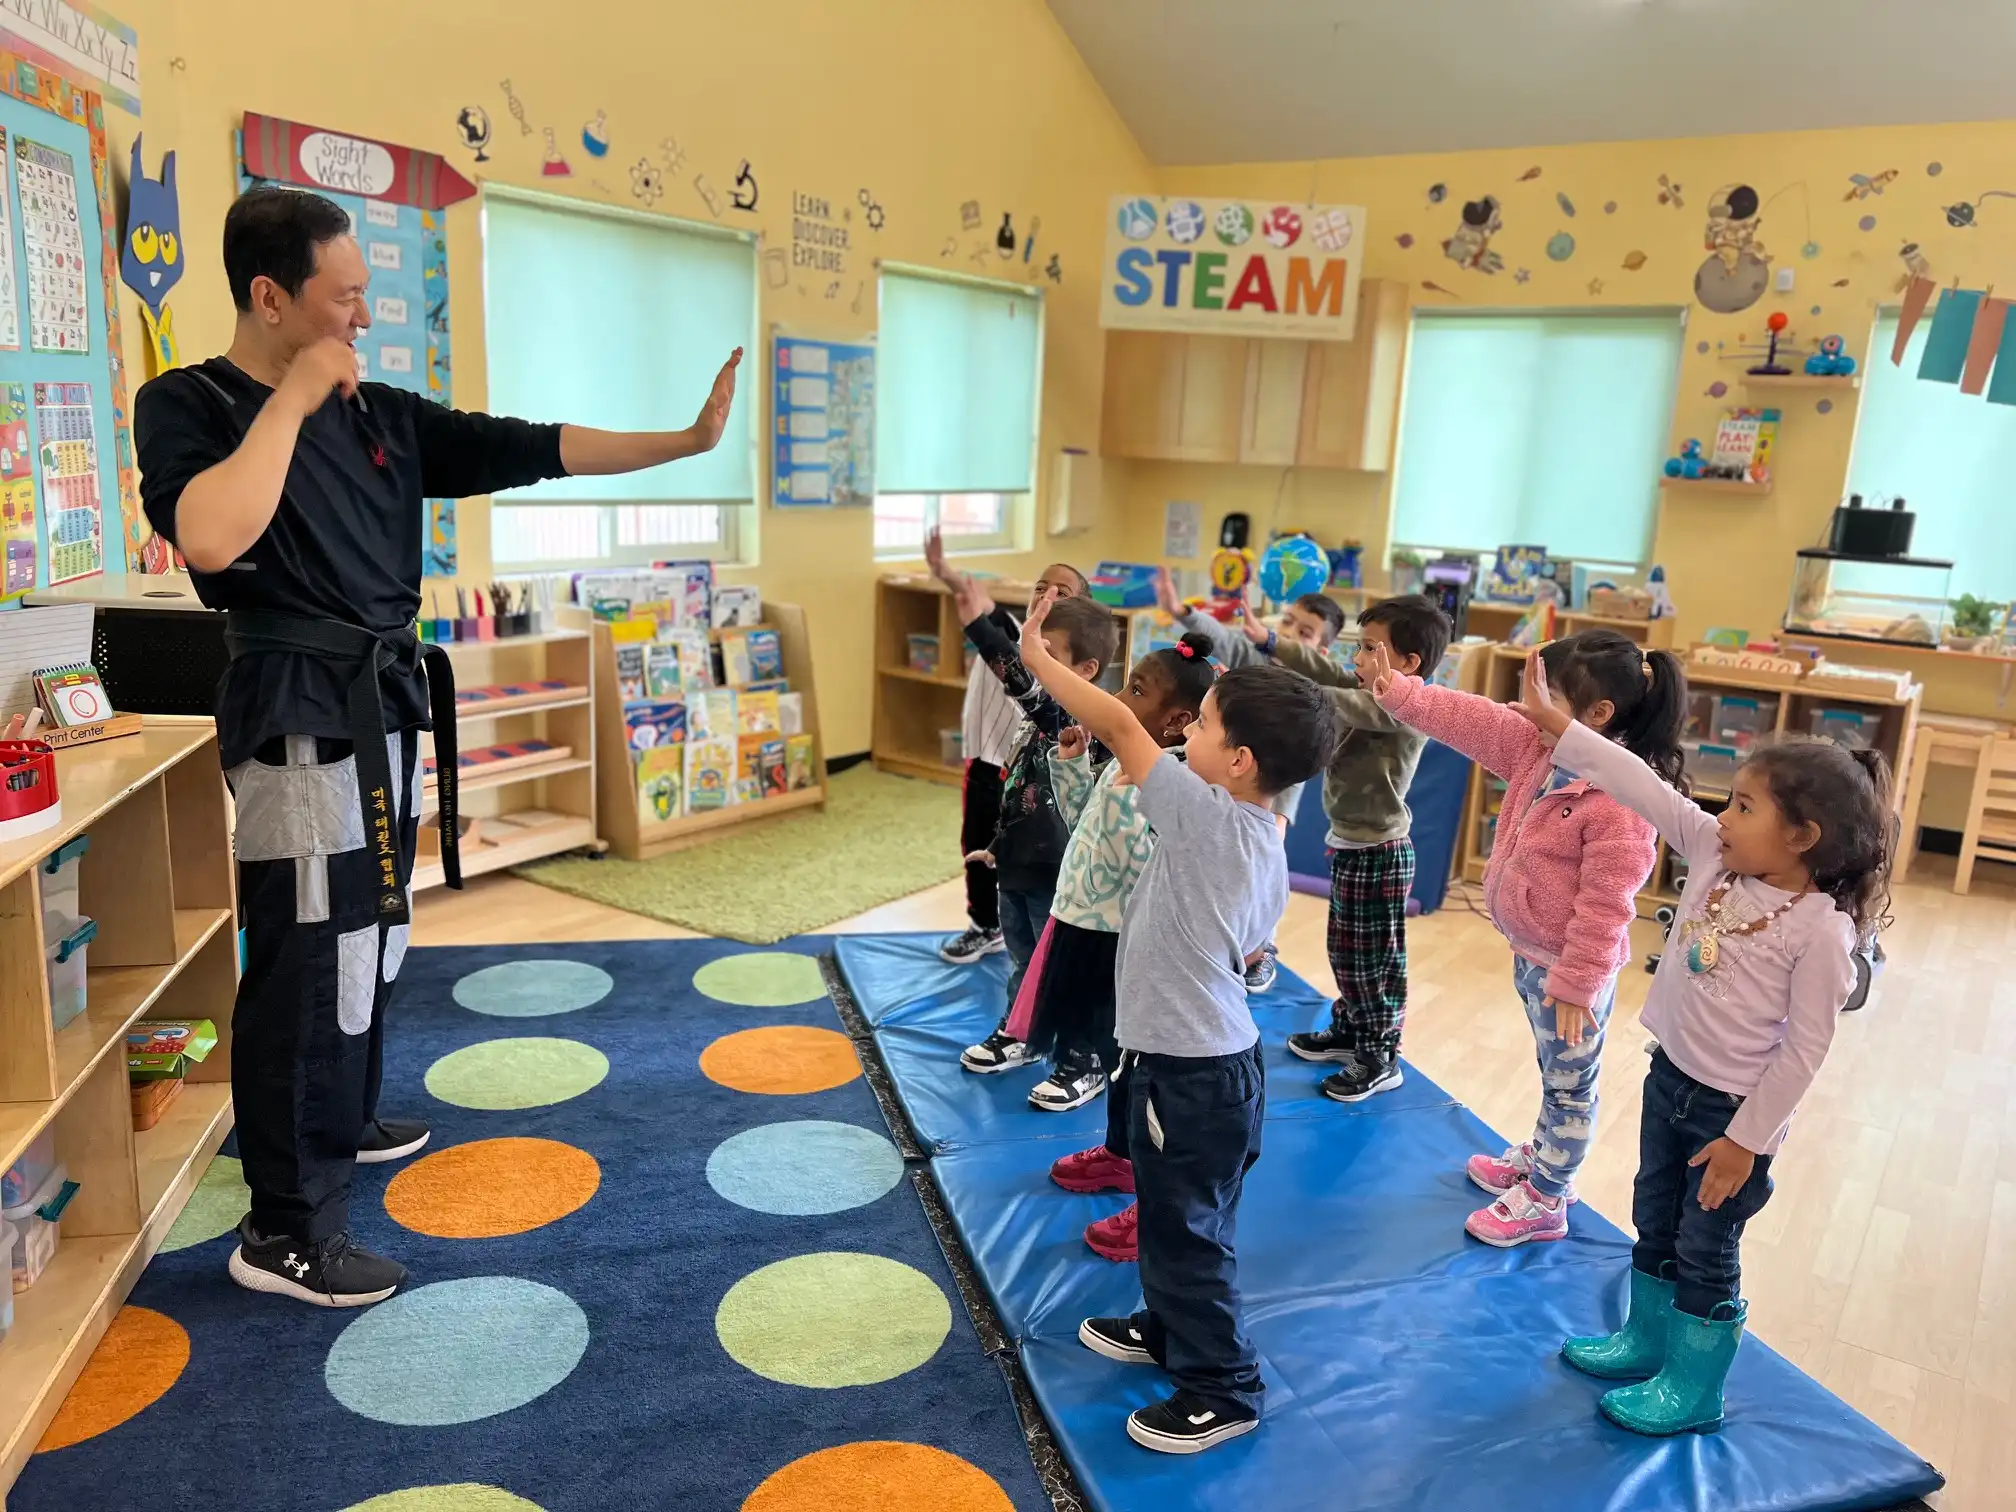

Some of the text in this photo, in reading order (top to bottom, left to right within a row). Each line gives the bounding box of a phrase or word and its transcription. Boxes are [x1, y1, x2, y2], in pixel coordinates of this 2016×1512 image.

[321, 135, 368, 166] Sight
[315, 156, 374, 192] Words
[1114, 247, 1347, 317] STEAM
[44, 726, 105, 745] Print Center
